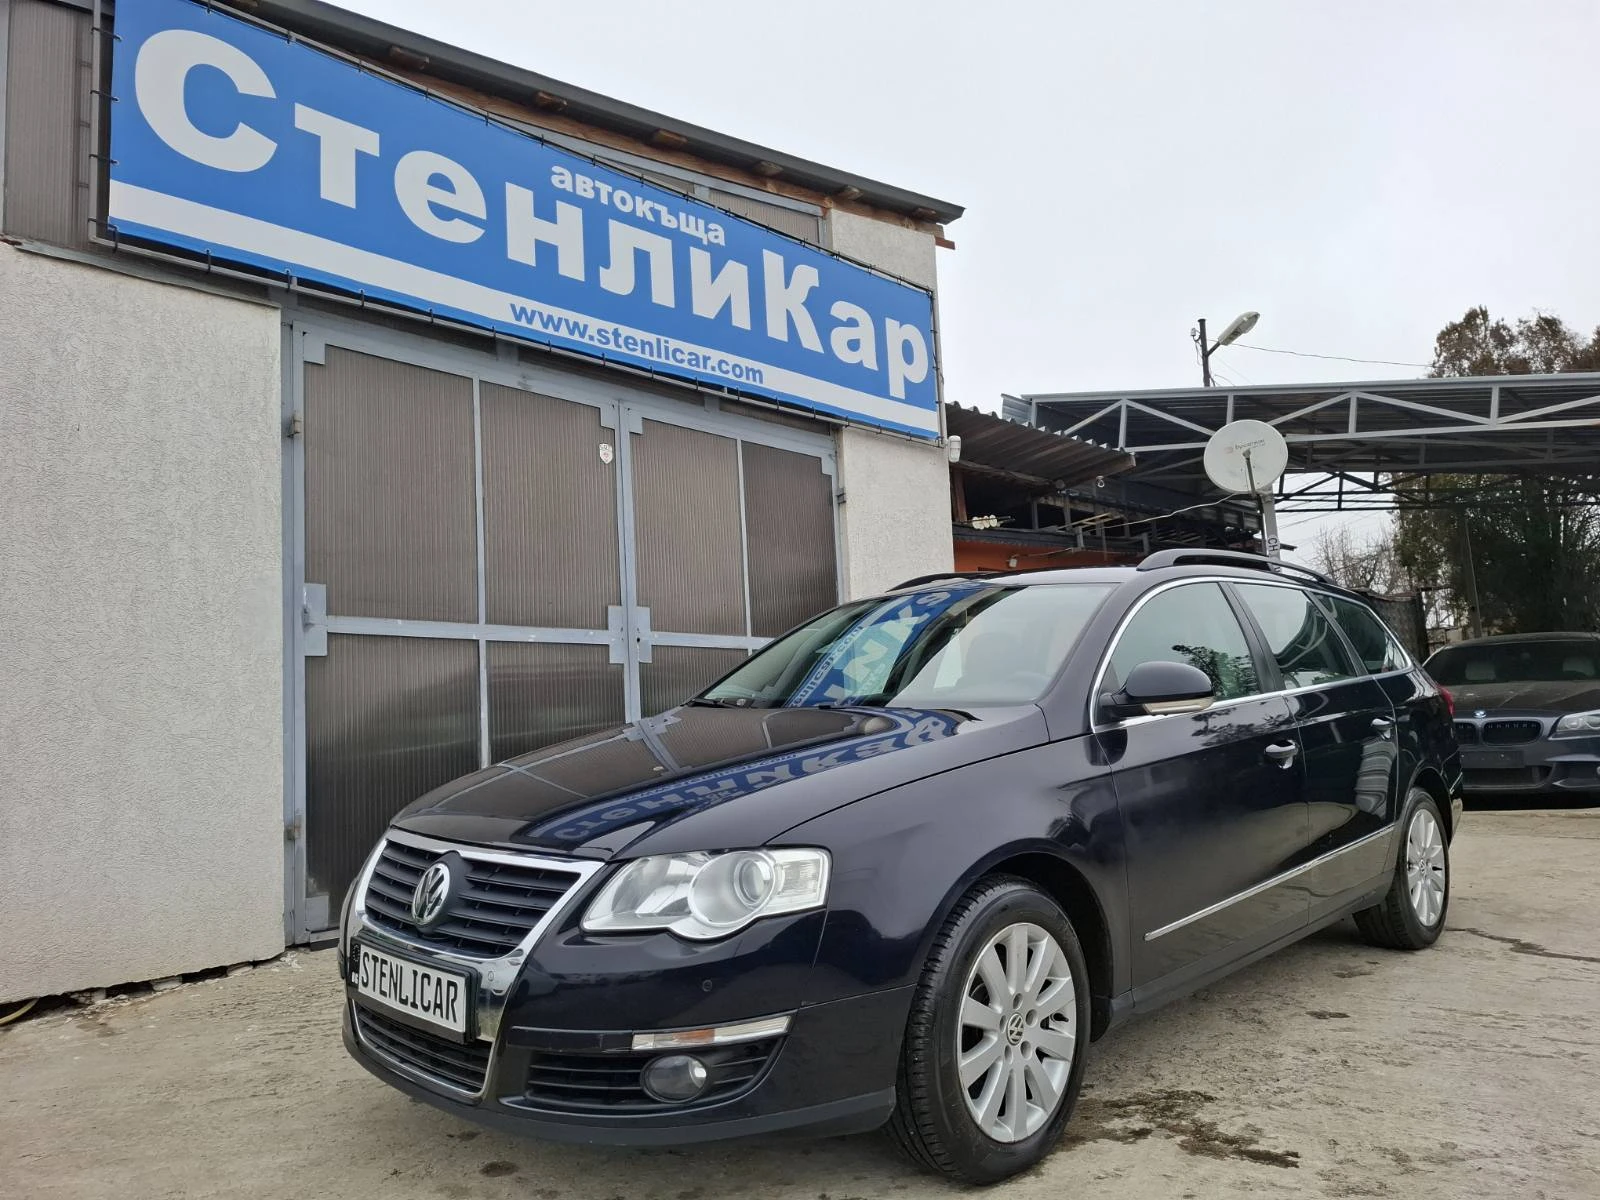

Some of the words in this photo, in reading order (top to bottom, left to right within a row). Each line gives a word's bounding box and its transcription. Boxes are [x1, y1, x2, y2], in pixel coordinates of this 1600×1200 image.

[134, 28, 929, 399] СтенлиКар
[551, 165, 726, 247] автокъща
[510, 303, 763, 384] www.stenlicar.com
[361, 951, 458, 1023] STENLICAR
